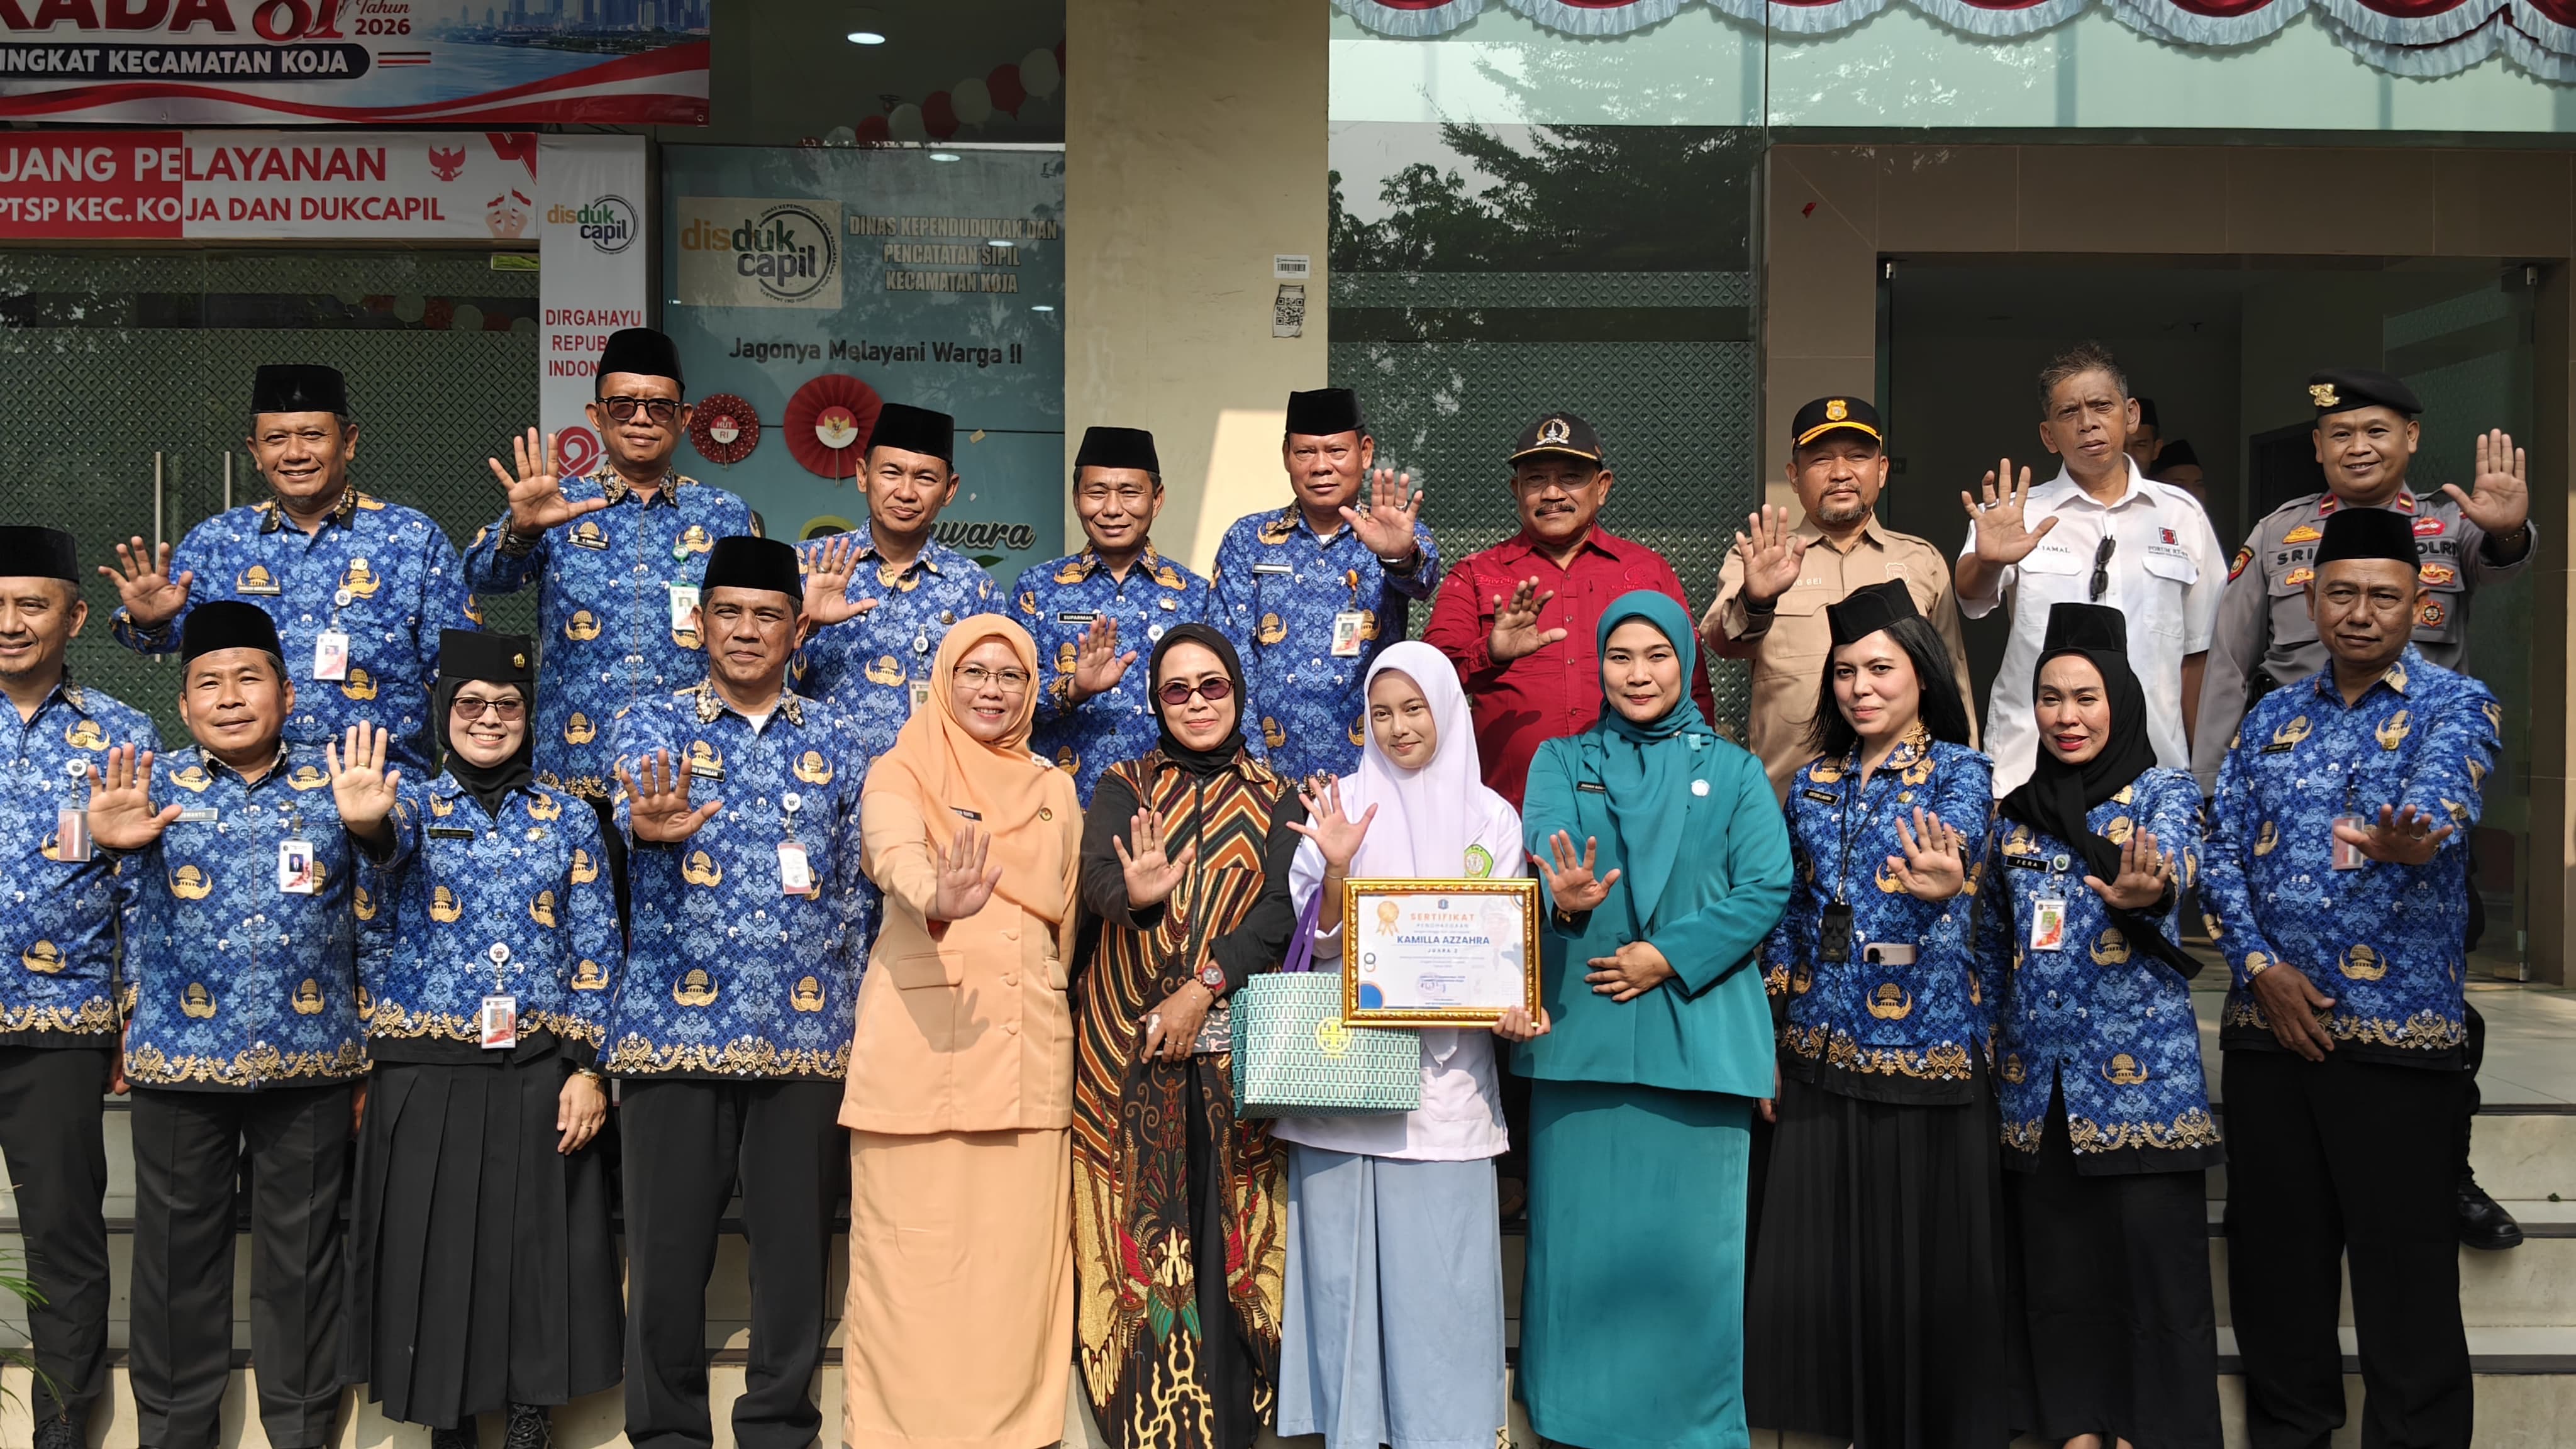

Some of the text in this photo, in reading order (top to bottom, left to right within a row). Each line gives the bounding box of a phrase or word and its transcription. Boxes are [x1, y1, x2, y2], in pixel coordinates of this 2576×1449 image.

[355, 18, 411, 35] 2026
[108, 50, 272, 74] KECAMATAN
[281, 50, 348, 73] KOJA
[134, 147, 386, 182] PELAYANAN
[229, 198, 291, 221] DAN
[301, 197, 445, 221] DUKCAPIL
[580, 219, 628, 245] capil
[849, 216, 1058, 240] DINAS KEPENDUDUKAN DAN
[737, 245, 816, 287] capil
[883, 243, 1021, 266] PENCATATAN SIPIL
[885, 270, 1018, 293] KECAMATAN KOJA
[546, 309, 641, 326] DIRGAHAYU
[729, 337, 820, 364] Jagonya
[829, 340, 926, 367] Melayani
[932, 341, 1002, 368] Warga
[2277, 548, 2313, 565] SRI
[2016, 859, 2038, 867] FERA
[1410, 913, 1475, 921] SERTIFIKAT
[1397, 935, 1491, 945] KAMILLA AZZAHRA
